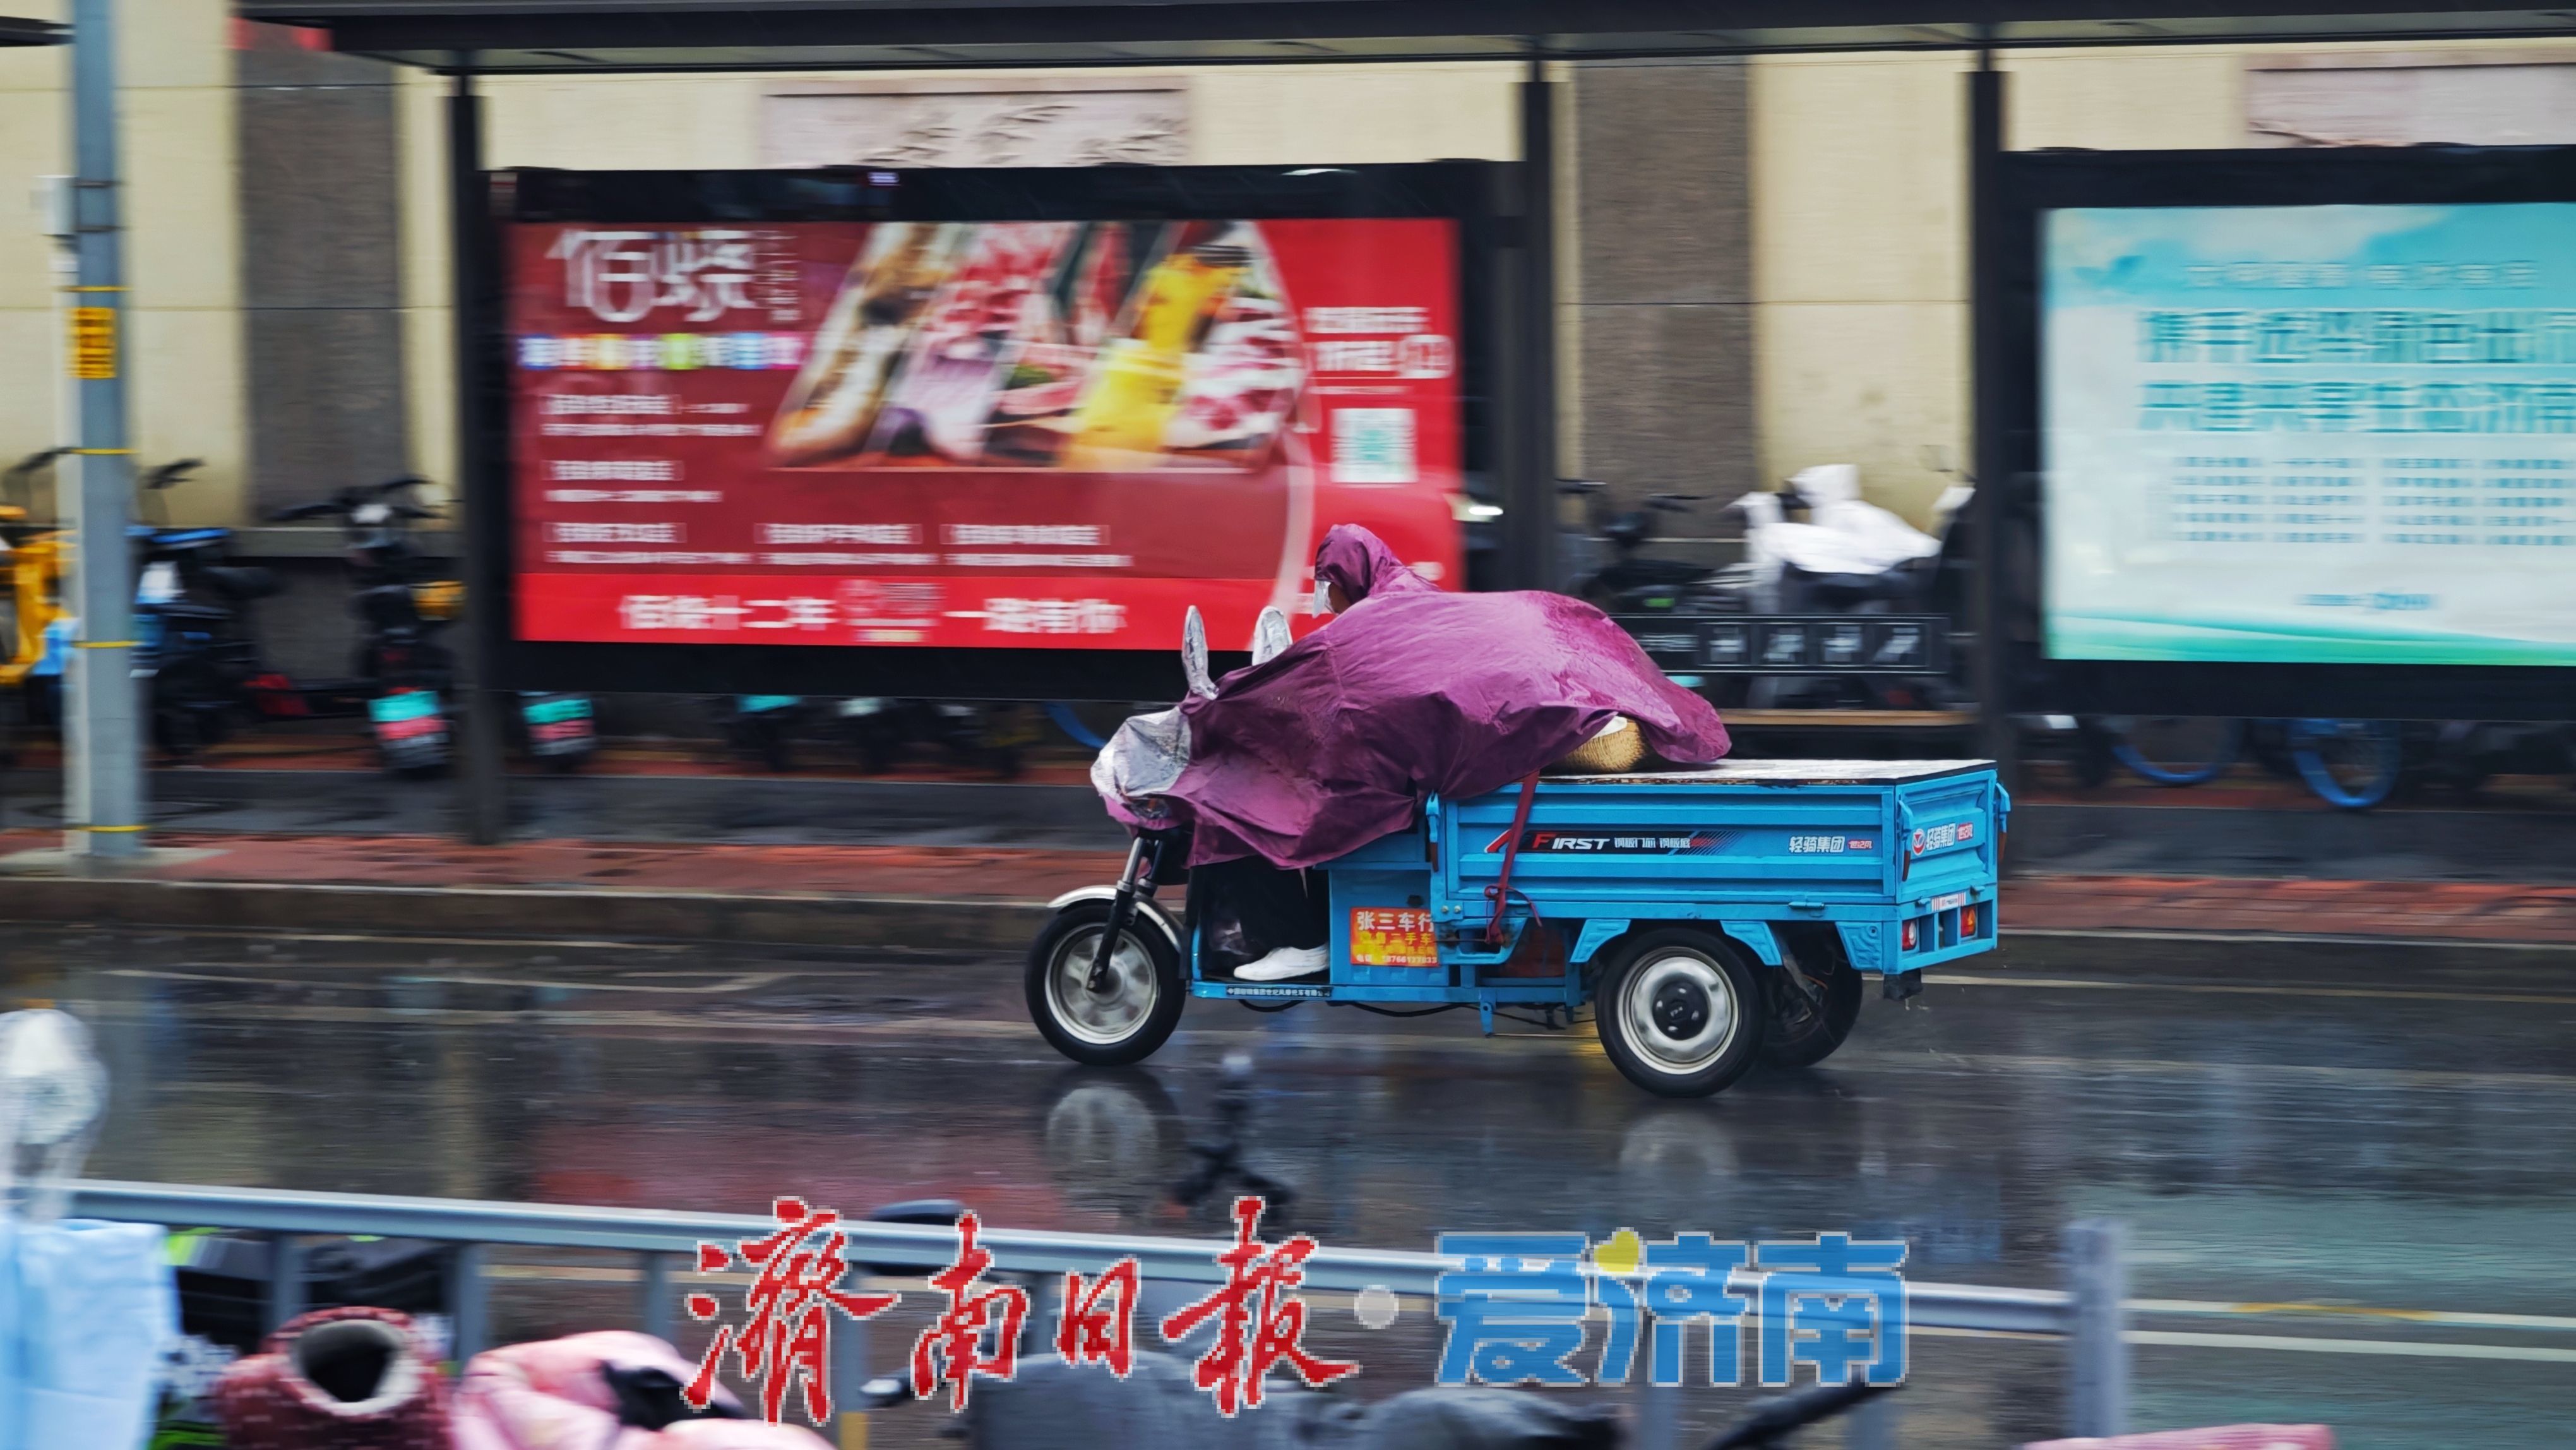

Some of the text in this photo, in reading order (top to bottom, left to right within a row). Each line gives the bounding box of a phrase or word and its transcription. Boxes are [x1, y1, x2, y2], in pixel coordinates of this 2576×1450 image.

[1532, 833, 1611, 850] FIRST
[1789, 836, 1846, 853] 轻骑集团
[1926, 822, 1957, 851] 轻骑集团
[1356, 910, 1434, 932] 张三车行
